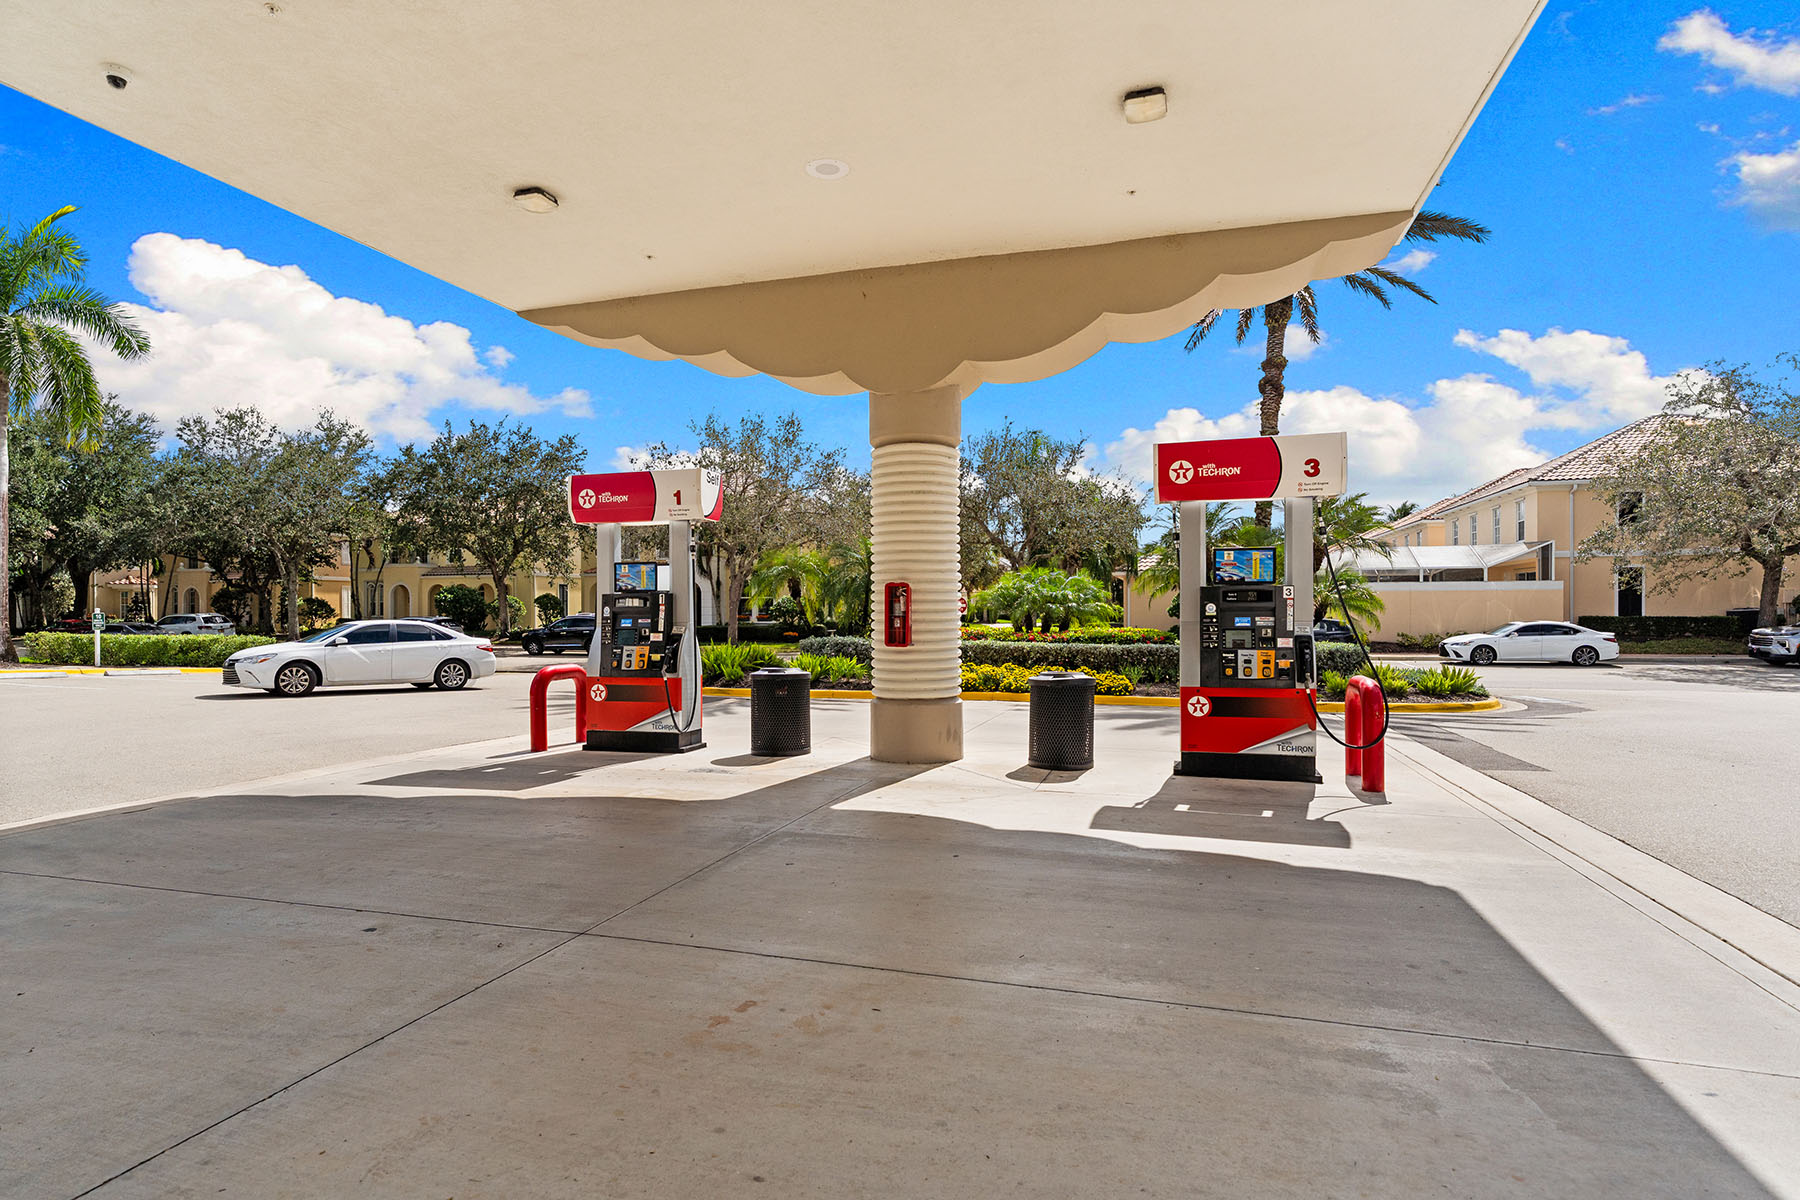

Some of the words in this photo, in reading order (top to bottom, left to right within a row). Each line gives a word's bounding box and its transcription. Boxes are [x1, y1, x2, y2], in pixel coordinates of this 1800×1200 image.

[1197, 466, 1241, 477] TECHRON
[1304, 459, 1320, 477] 3
[706, 471, 719, 487] Self
[598, 495, 629, 504] TECHRON
[673, 490, 682, 505] 1
[1285, 587, 1292, 597] 3
[1277, 744, 1314, 754] TECHRON
